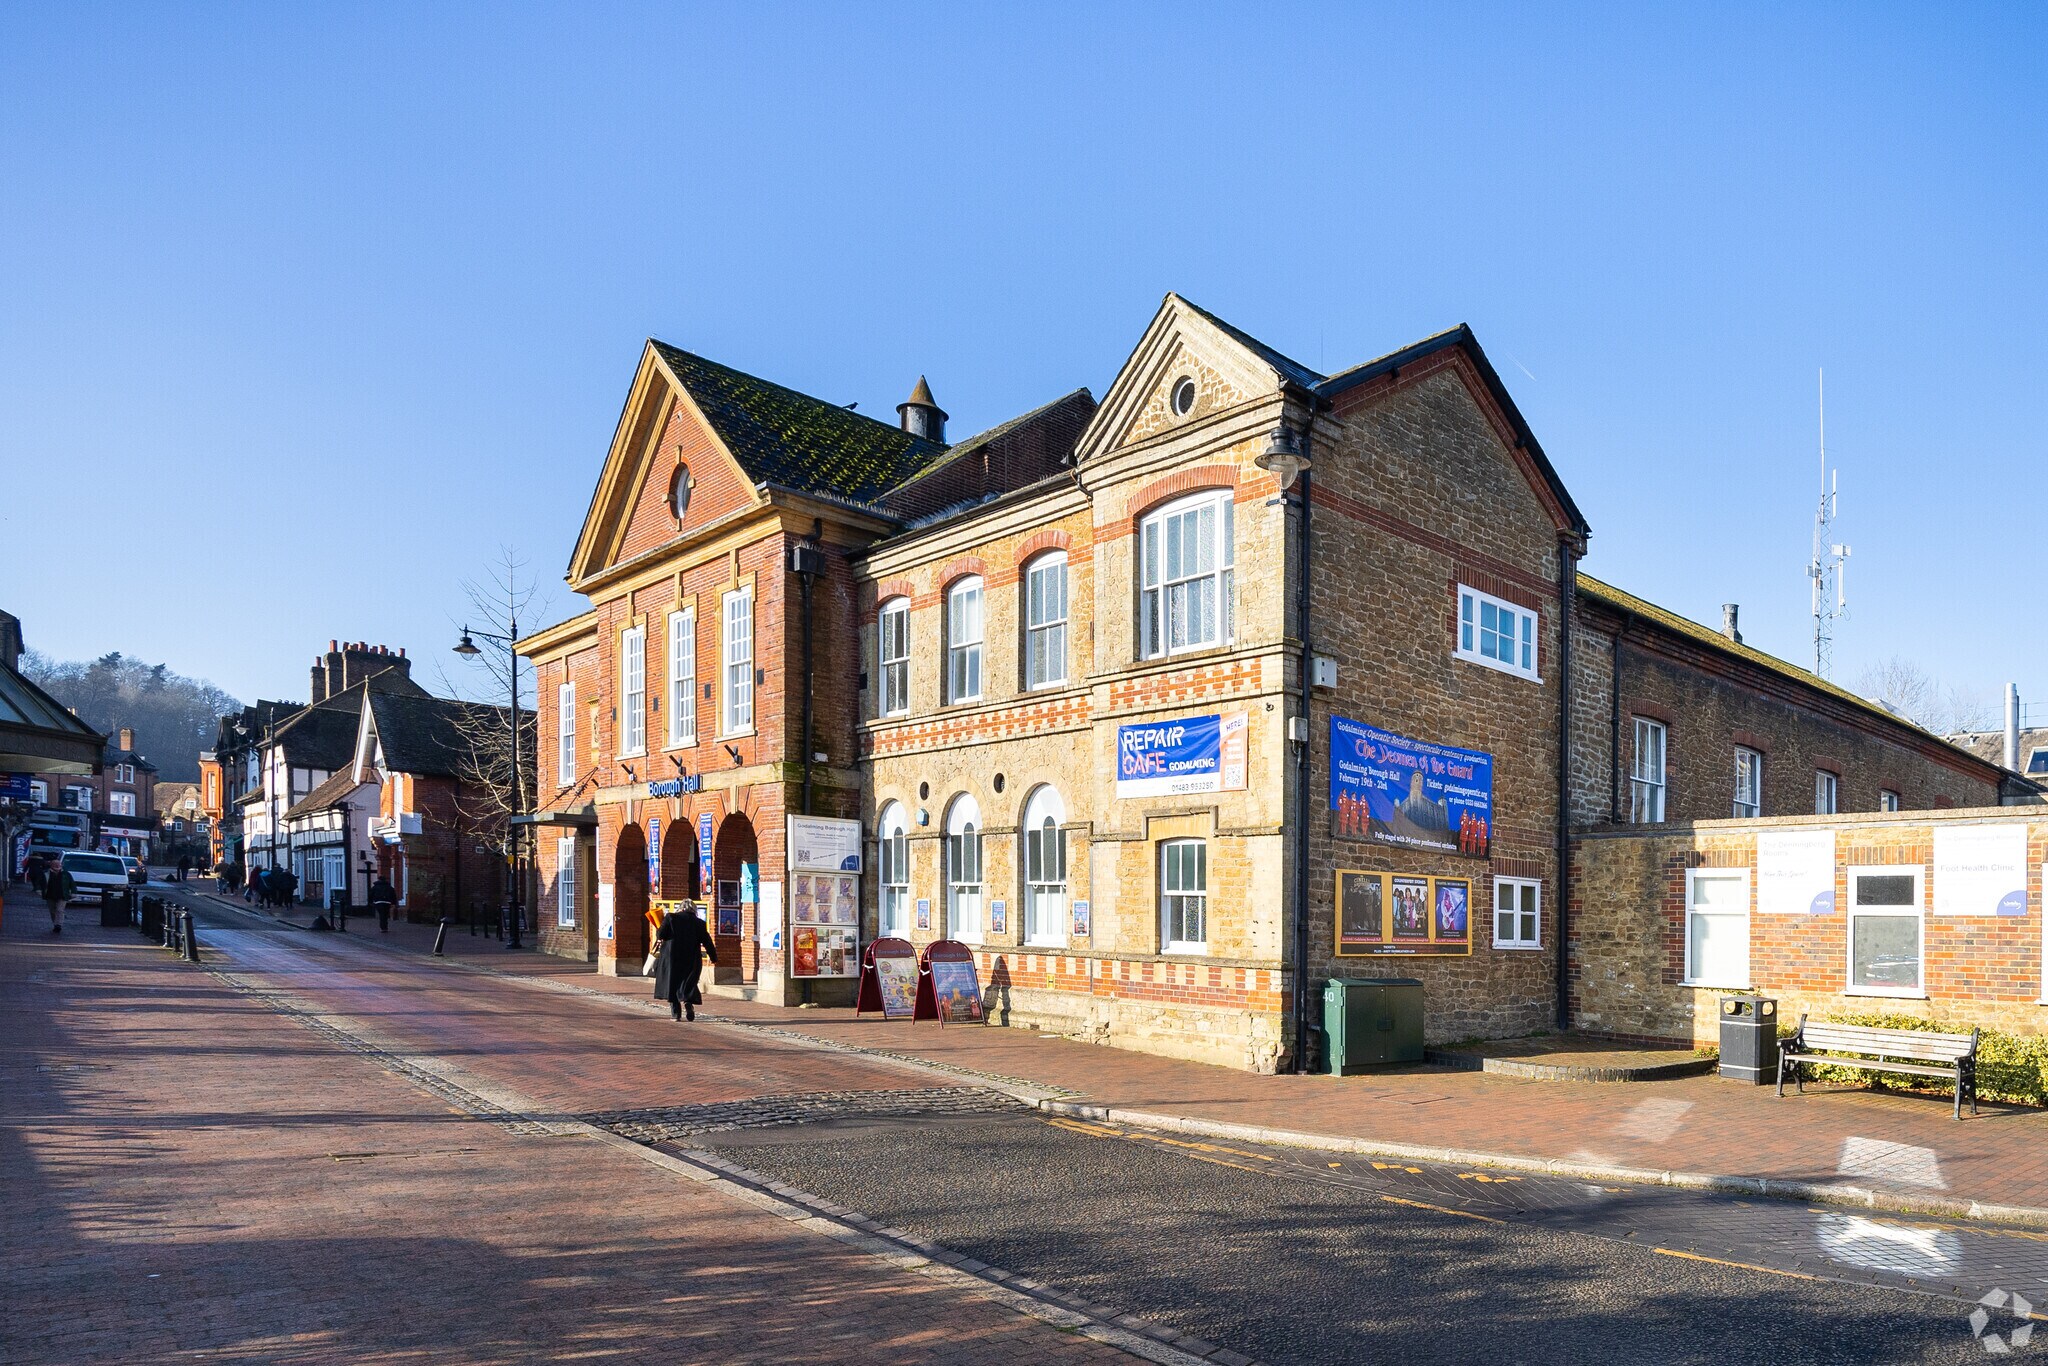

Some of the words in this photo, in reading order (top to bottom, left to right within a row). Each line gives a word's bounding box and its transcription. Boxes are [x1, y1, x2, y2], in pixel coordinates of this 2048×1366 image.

[1123, 726, 1185, 751] REPAIR
[1337, 721, 1367, 739] Godalming
[1367, 729, 1391, 743] Operatic
[1391, 735, 1411, 750] Society
[1414, 742, 1442, 755] spectacular
[1123, 752, 1167, 775] CAFE
[1169, 758, 1215, 772] GODALMING
[1339, 760, 1368, 776] Godalming
[1368, 765, 1389, 780] Borough
[1389, 770, 1400, 781] Hall
[1355, 738, 1376, 760] The
[1378, 743, 1418, 768] Yeomen
[1419, 755, 1429, 774] of
[1430, 756, 1446, 776] the
[1447, 760, 1473, 780] Guard
[648, 777, 680, 797] Borough
[683, 774, 699, 792] Hall
[1339, 772, 1360, 787] February
[1361, 776, 1373, 787] 19th
[797, 822, 824, 831] Godalming
[1940, 864, 1959, 872] Foot
[1961, 864, 1988, 872] Health
[1990, 863, 2015, 872] Clinic
